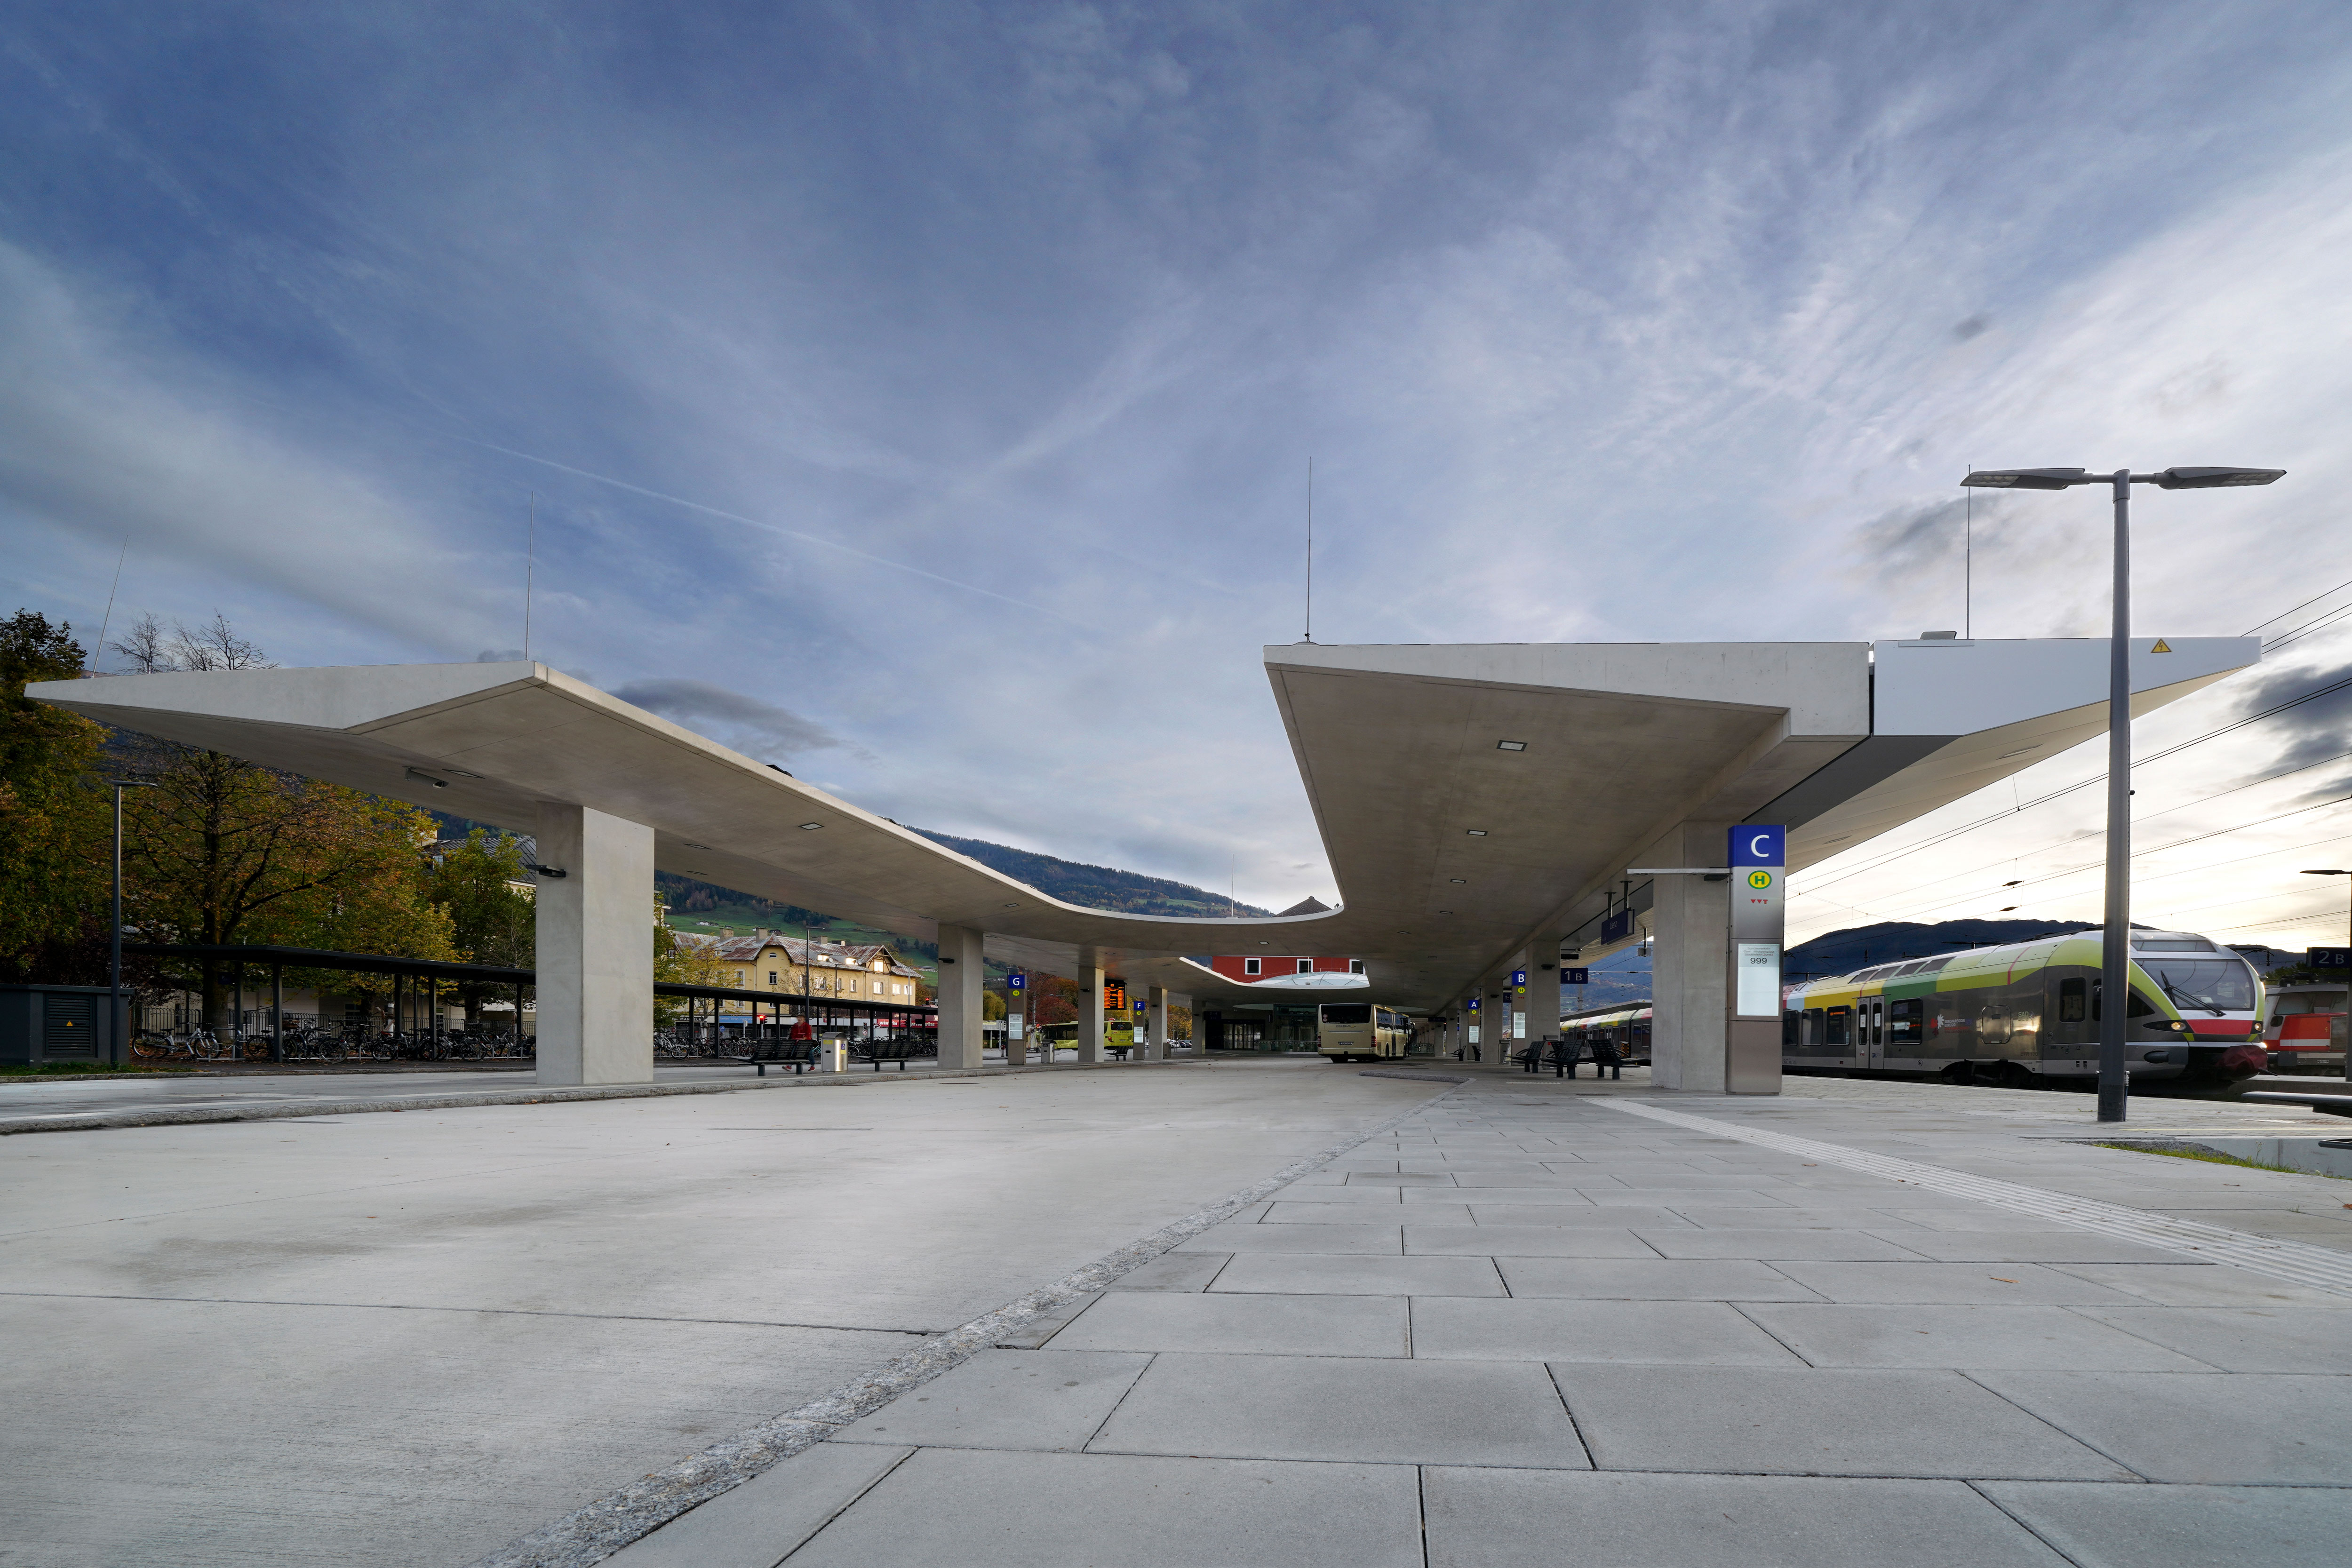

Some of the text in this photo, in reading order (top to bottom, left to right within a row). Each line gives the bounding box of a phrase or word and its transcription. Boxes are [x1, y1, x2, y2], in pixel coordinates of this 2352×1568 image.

[1751, 835, 1770, 857] C
[1754, 876, 1765, 884] H
[2319, 950, 2344, 964] 2 B
[1518, 974, 1524, 982] B
[1565, 971, 1570, 981] 1
